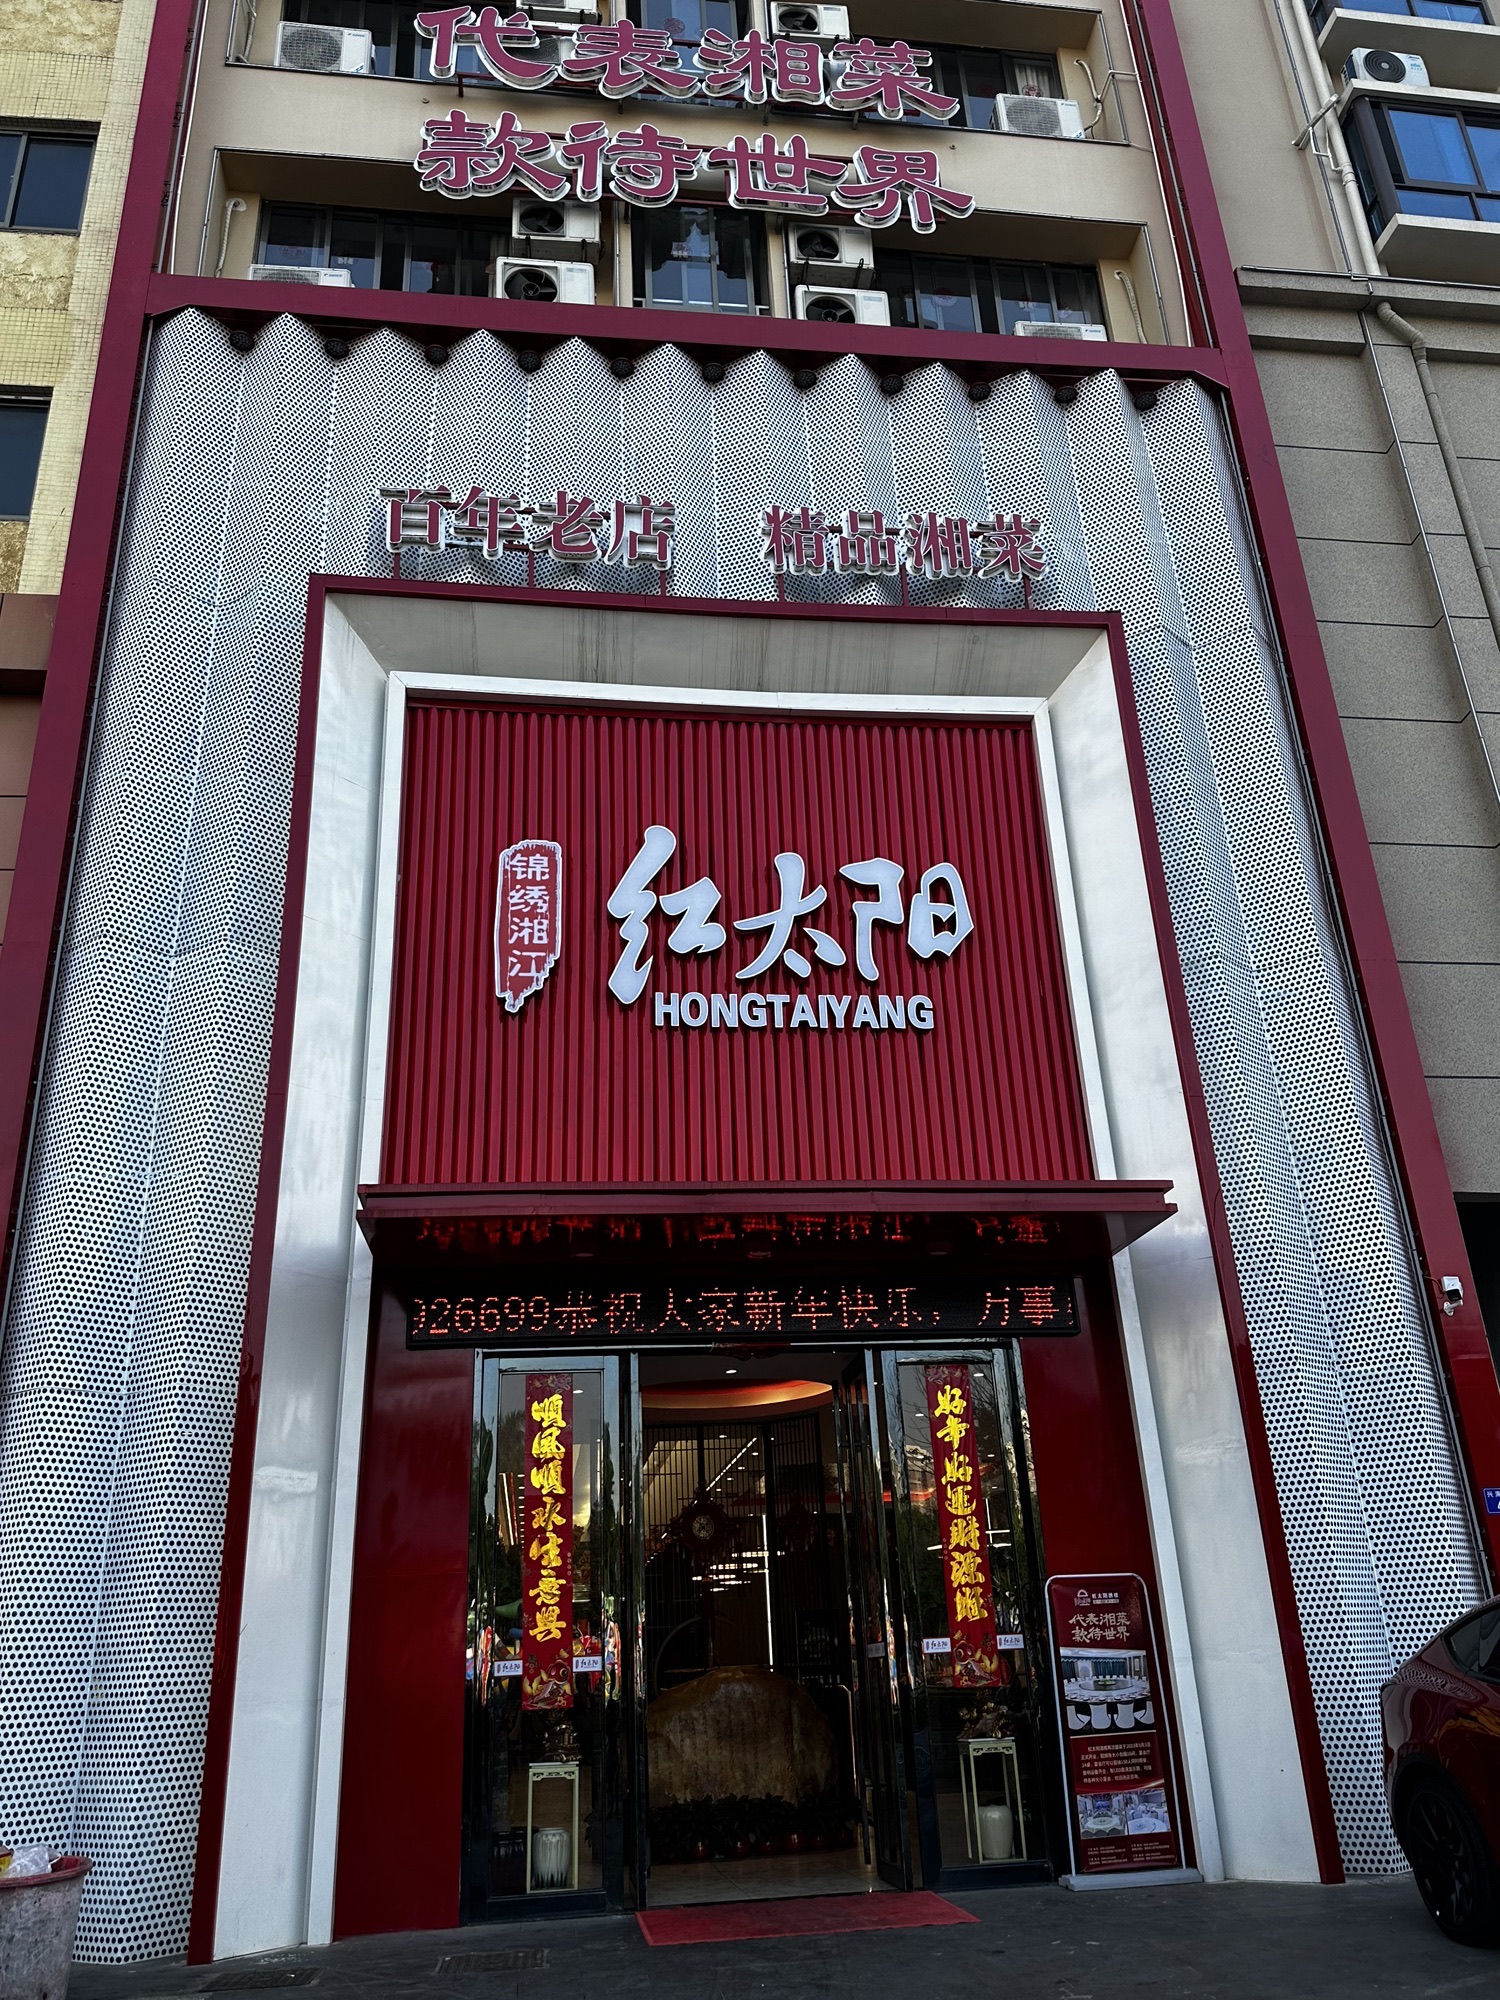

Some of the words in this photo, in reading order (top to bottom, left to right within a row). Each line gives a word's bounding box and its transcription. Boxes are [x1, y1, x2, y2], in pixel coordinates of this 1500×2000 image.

[414, 4, 962, 120] 代表湘菜
[414, 108, 976, 235] 款待世界
[380, 484, 676, 570] 百年老店
[761, 502, 1049, 583] 精品湘菜
[508, 853, 549, 978] 锦绣湘江
[607, 825, 975, 1005] 红太阳
[654, 991, 934, 1030] HONGTAIYANG
[1068, 1612, 1131, 1627] 代表湘菜
[1071, 1626, 1130, 1643] 款待世界
